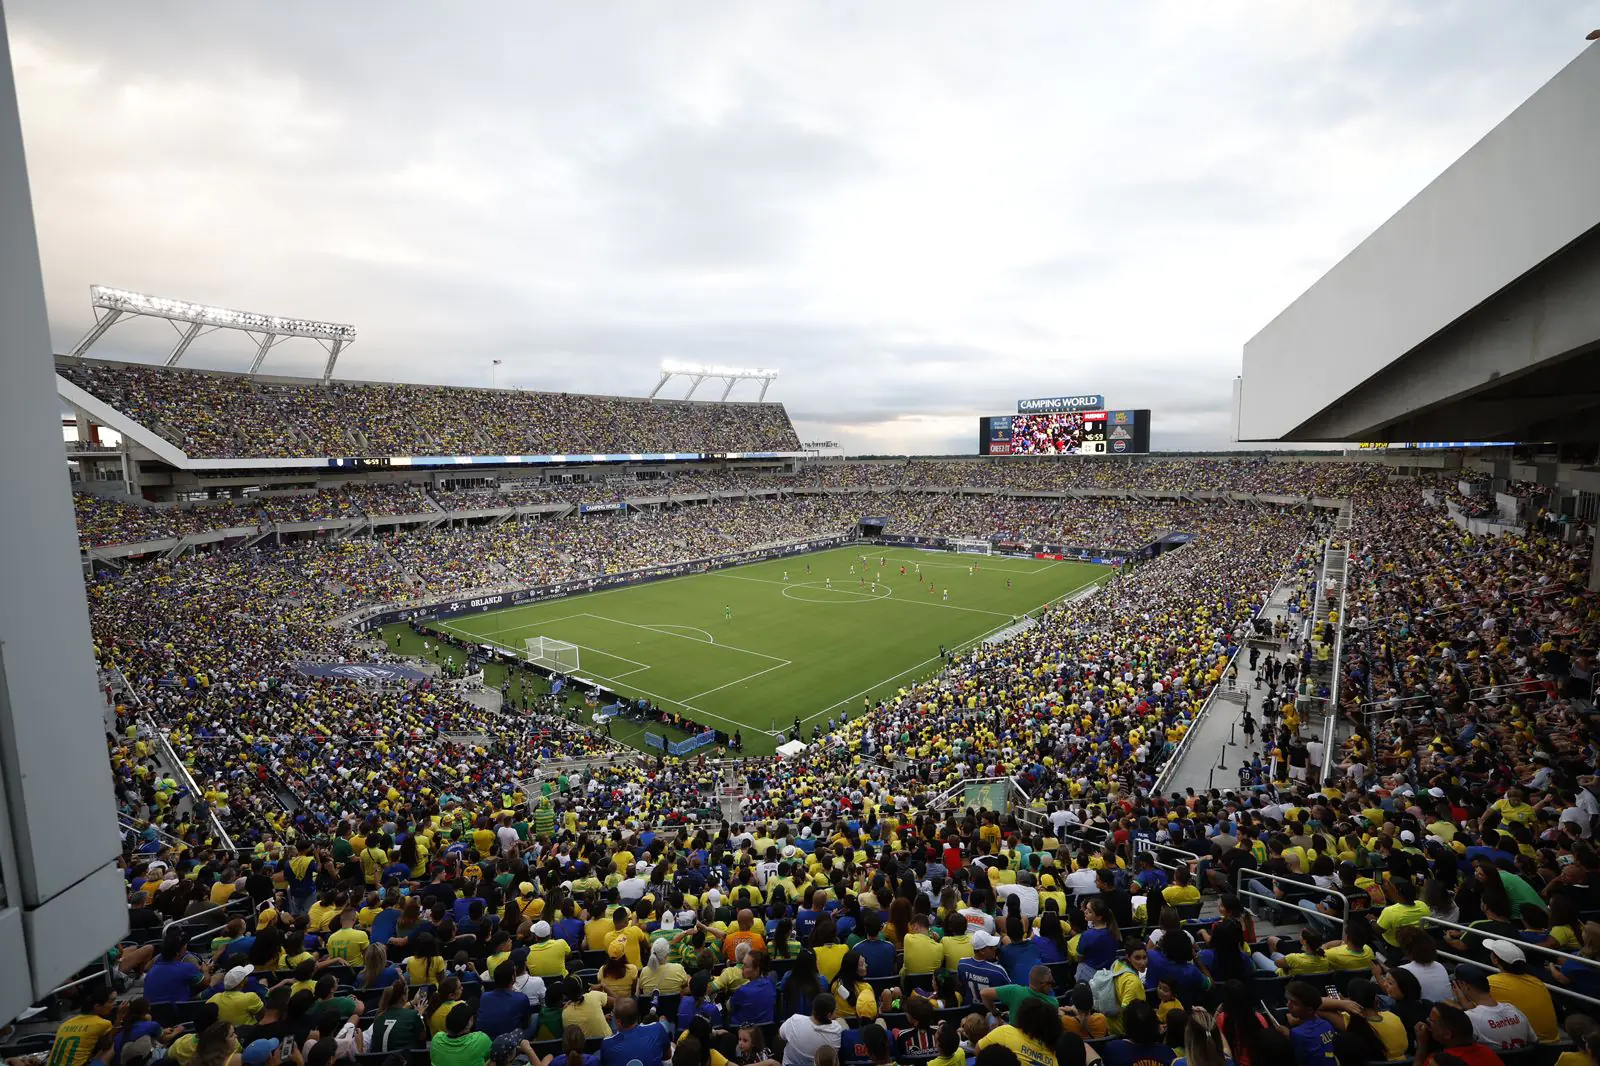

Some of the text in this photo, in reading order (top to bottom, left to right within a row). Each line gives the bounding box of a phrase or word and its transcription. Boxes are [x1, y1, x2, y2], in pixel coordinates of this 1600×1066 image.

[1020, 396, 1097, 410] CAMPING WORLD
[964, 971, 990, 984] FABINHO
[1488, 1014, 1521, 1029] Banrisul
[380, 1019, 397, 1053] 7
[49, 1036, 81, 1066] 10
[1020, 1044, 1054, 1066] RONALDO
